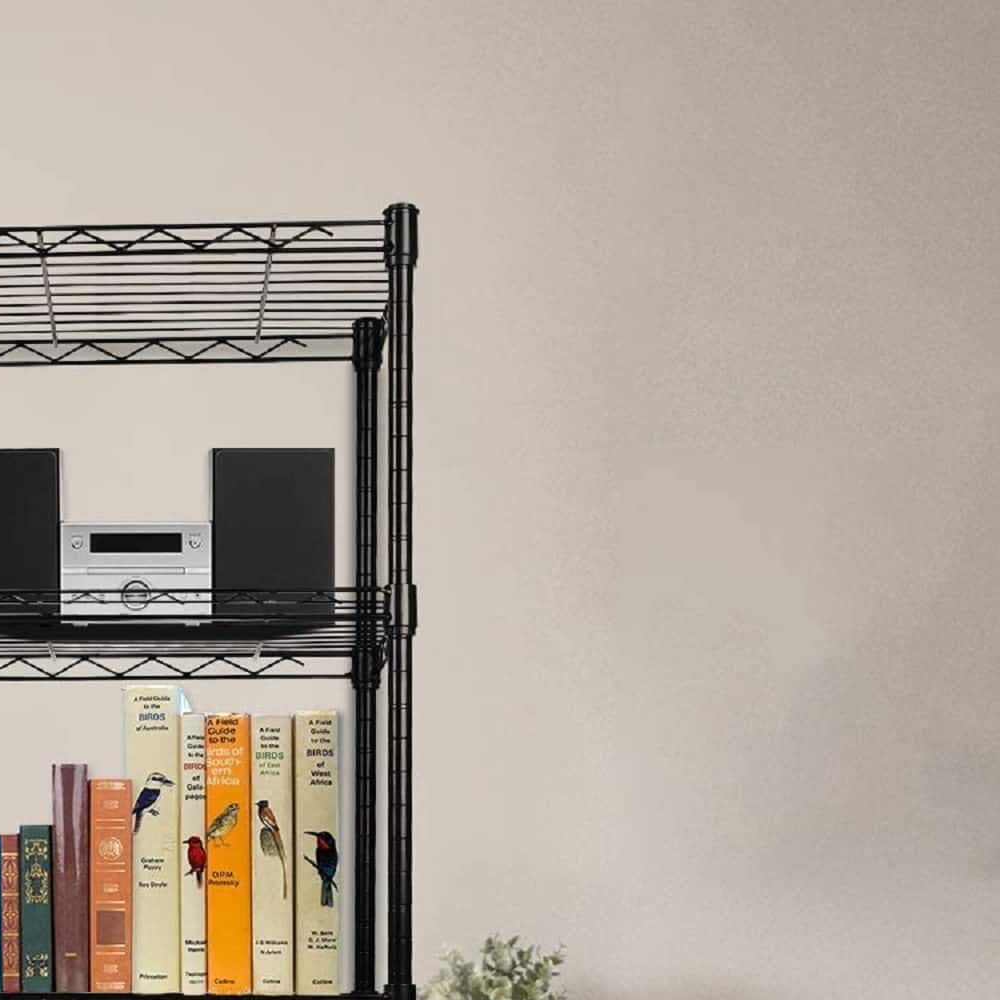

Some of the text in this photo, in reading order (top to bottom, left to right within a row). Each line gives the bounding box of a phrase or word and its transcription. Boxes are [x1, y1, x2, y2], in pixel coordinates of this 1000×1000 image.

[139, 713, 166, 721] BIRDS
[208, 727, 236, 735] Guide
[307, 749, 334, 757] BIRDS
